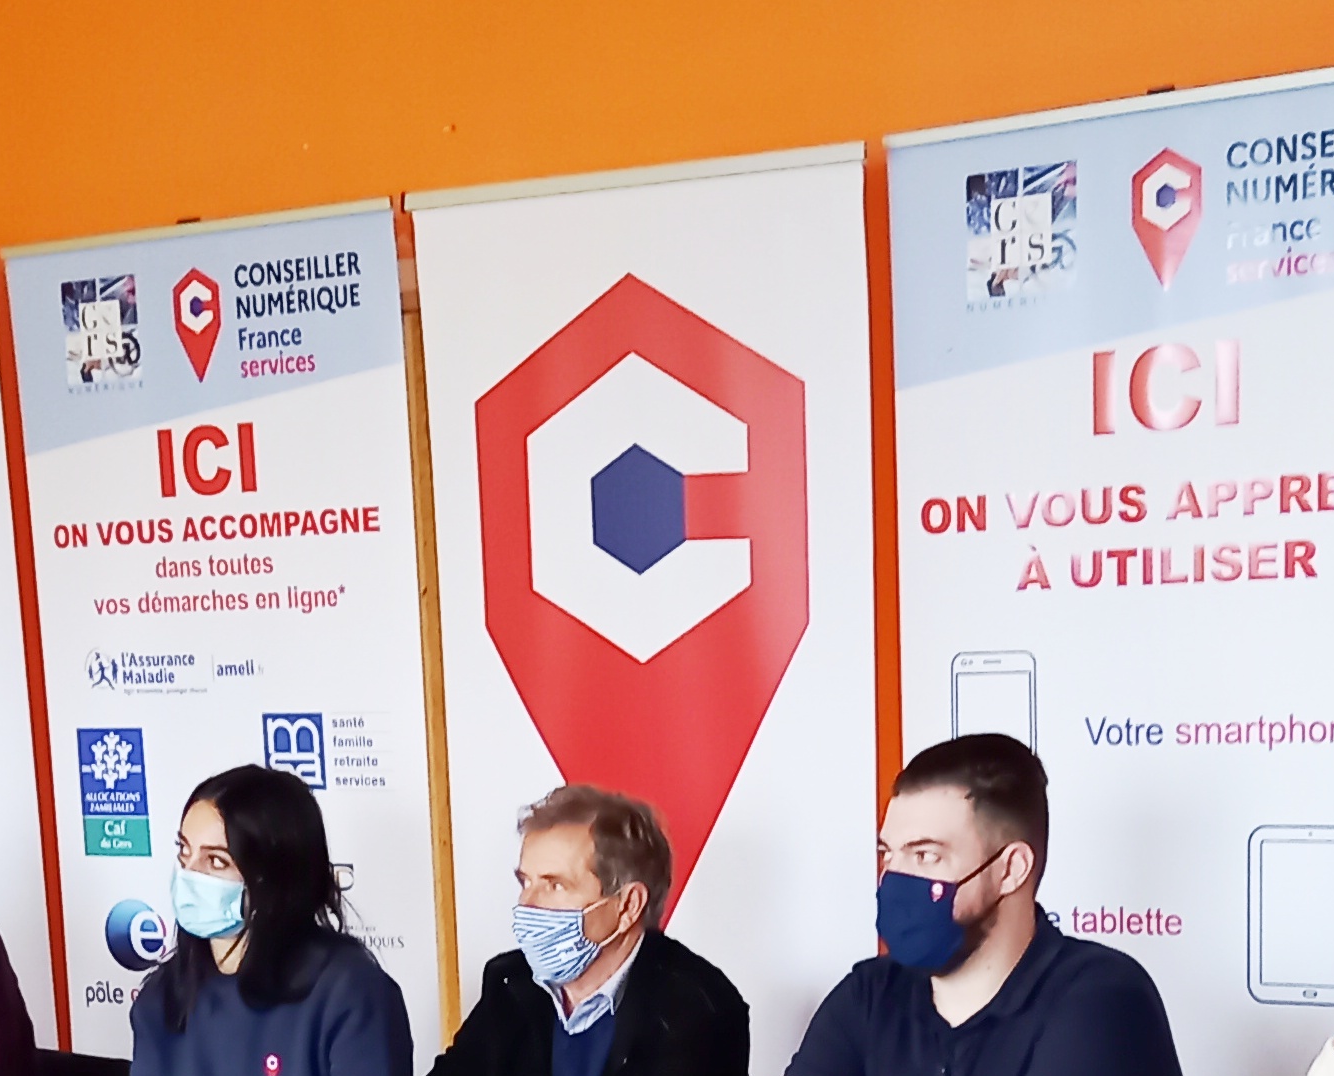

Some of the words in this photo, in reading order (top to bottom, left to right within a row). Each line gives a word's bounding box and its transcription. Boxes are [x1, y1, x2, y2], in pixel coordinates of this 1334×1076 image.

[234, 251, 361, 289] CONSEILLER
[235, 283, 361, 320] NUMÉRIQUE
[238, 327, 302, 351] France
[240, 350, 316, 379] services
[1092, 338, 1240, 436] ICI
[156, 422, 257, 498] ICI
[920, 494, 987, 534] ON
[1004, 484, 1148, 530] VOUS
[53, 523, 88, 549] ON
[95, 518, 174, 546] VOUS
[182, 506, 381, 542] ACCOMPAGNE
[155, 556, 202, 579] dans
[208, 553, 274, 577] toutes
[1016, 545, 1052, 591] À
[1069, 540, 1318, 588] UTILISER
[93, 598, 131, 615] vos
[138, 590, 249, 614] démarches
[255, 593, 281, 610] en
[121, 651, 196, 668] l'Assurance
[122, 669, 175, 684] Maladie
[331, 716, 365, 728] santé
[1084, 716, 1164, 746] Votre
[332, 735, 373, 748] famille
[334, 756, 378, 767] retraite
[335, 774, 386, 787] services
[104, 819, 126, 836] Caf
[1071, 906, 1183, 936] tablette
[85, 980, 124, 1008] pôle
